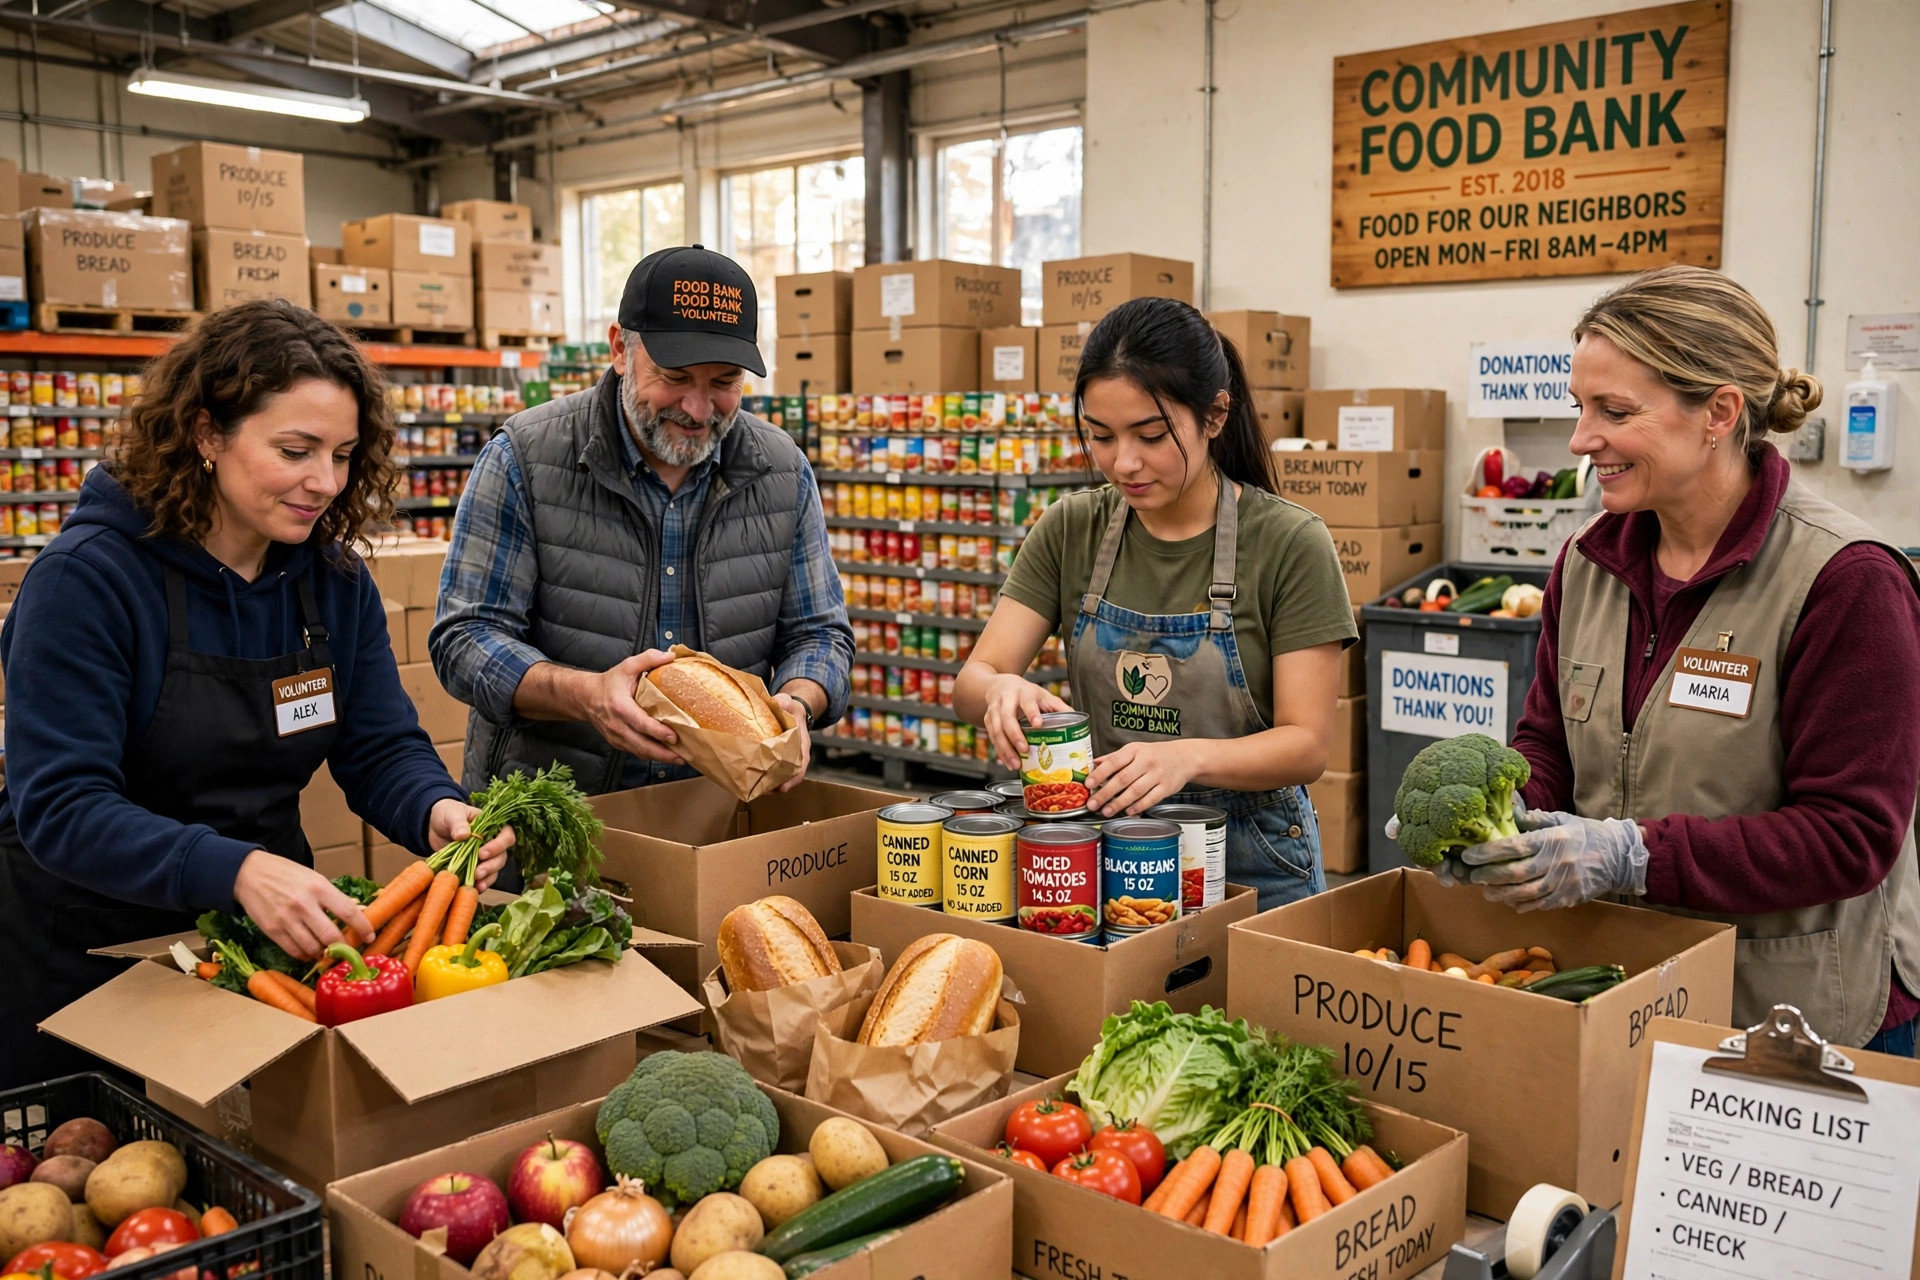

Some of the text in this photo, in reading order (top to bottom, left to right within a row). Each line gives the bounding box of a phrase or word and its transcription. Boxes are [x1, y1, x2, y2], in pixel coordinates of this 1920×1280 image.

[1360, 25, 1690, 117] COMMUNITY
[1360, 89, 1687, 176] FOOD BANK
[219, 162, 288, 188] PRODUCE
[1460, 167, 1566, 198] EST. 2018
[237, 186, 275, 209] 10/15
[1359, 190, 1688, 240] FOOD FOR OUR NEIGHBORS
[62, 228, 136, 249] PRODUCE
[232, 241, 288, 262] BREAD
[1374, 245, 1430, 270] OPEN
[76, 253, 131, 273] BREAD
[237, 266, 280, 281] FRESH
[954, 276, 1003, 296] PRODUCE
[1056, 266, 1114, 287] PRODUCE
[674, 280, 742, 301] FOOD BANK
[1071, 290, 1103, 311] 10/15
[673, 294, 743, 314] FOOD BANK
[1480, 354, 1571, 375] DONATIONS
[1481, 381, 1568, 400] THANK YOU!
[1283, 480, 1368, 497] FRESH TODAY
[1683, 655, 1749, 677] VOLUNTEER
[278, 677, 328, 699] VOLUNTEER
[1393, 667, 1495, 698] DONATIONS
[1688, 682, 1730, 702] MARIA
[293, 701, 319, 721] ALEX
[1113, 701, 1180, 721] COMMUNITY
[1393, 696, 1494, 727] THANK YOU!
[1113, 715, 1180, 735] FOOD BANK
[882, 834, 930, 851] CANNED
[767, 842, 848, 887] PRODUCE
[887, 851, 921, 867] CORN
[948, 846, 999, 864] CANNED
[1032, 854, 1071, 871] DICED
[953, 864, 989, 881] CORN
[1104, 857, 1176, 875] BLACK BEANS
[889, 870, 918, 884] 15 OZ
[1021, 867, 1087, 888] TOMATOES
[1123, 877, 1155, 891] 15 OZ
[880, 884, 934, 899] NO SALT ADDED
[956, 883, 985, 897] 15 OZ
[1032, 888, 1072, 903] 14.5 OZ
[947, 898, 1003, 913] NO SALT ADDED
[1294, 974, 1462, 1051] PRODUCE
[1344, 1042, 1428, 1093] 10/15
[1689, 1088, 1871, 1144] PACKING LIST
[1681, 1152, 1723, 1179] VEG
[1729, 1163, 1742, 1185] /
[1747, 1167, 1824, 1202] BREAD
[1829, 1186, 1843, 1209] /
[1676, 1188, 1787, 1234] CANNED /
[1336, 1195, 1416, 1271] BREAD
[1672, 1224, 1746, 1261] CHECK
[1385, 1222, 1436, 1275] TODAY
[1034, 1239, 1101, 1280] FRESH
